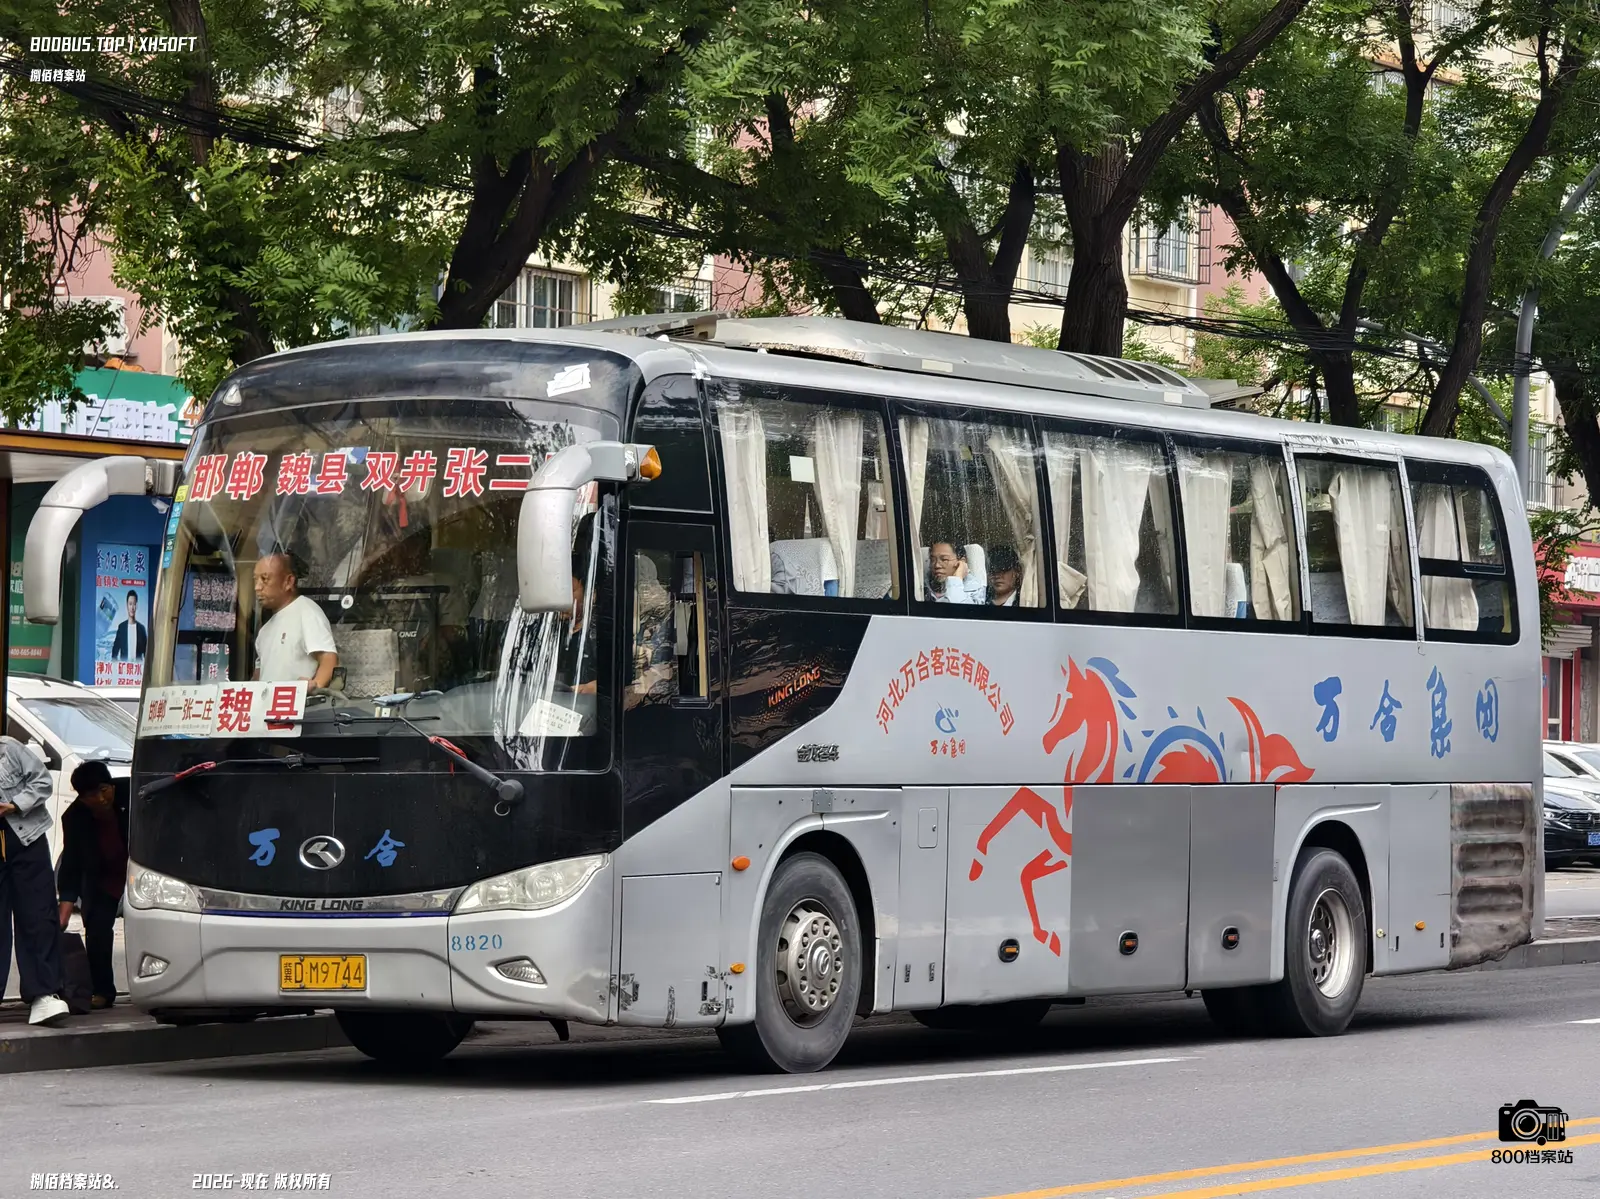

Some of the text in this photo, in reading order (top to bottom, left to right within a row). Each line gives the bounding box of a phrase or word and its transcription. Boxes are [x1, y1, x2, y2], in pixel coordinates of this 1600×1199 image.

[190, 451, 267, 502] 邯郸
[276, 451, 348, 496] 魏县
[361, 450, 437, 493] 双井
[443, 447, 553, 498] 张二
[768, 666, 821, 707] KING LONG
[875, 647, 1014, 735] 河北万合客运有限公司
[217, 686, 299, 732] 魏县
[248, 828, 280, 867] 万
[280, 899, 364, 911] KING LONG
[451, 933, 503, 952] 8820
